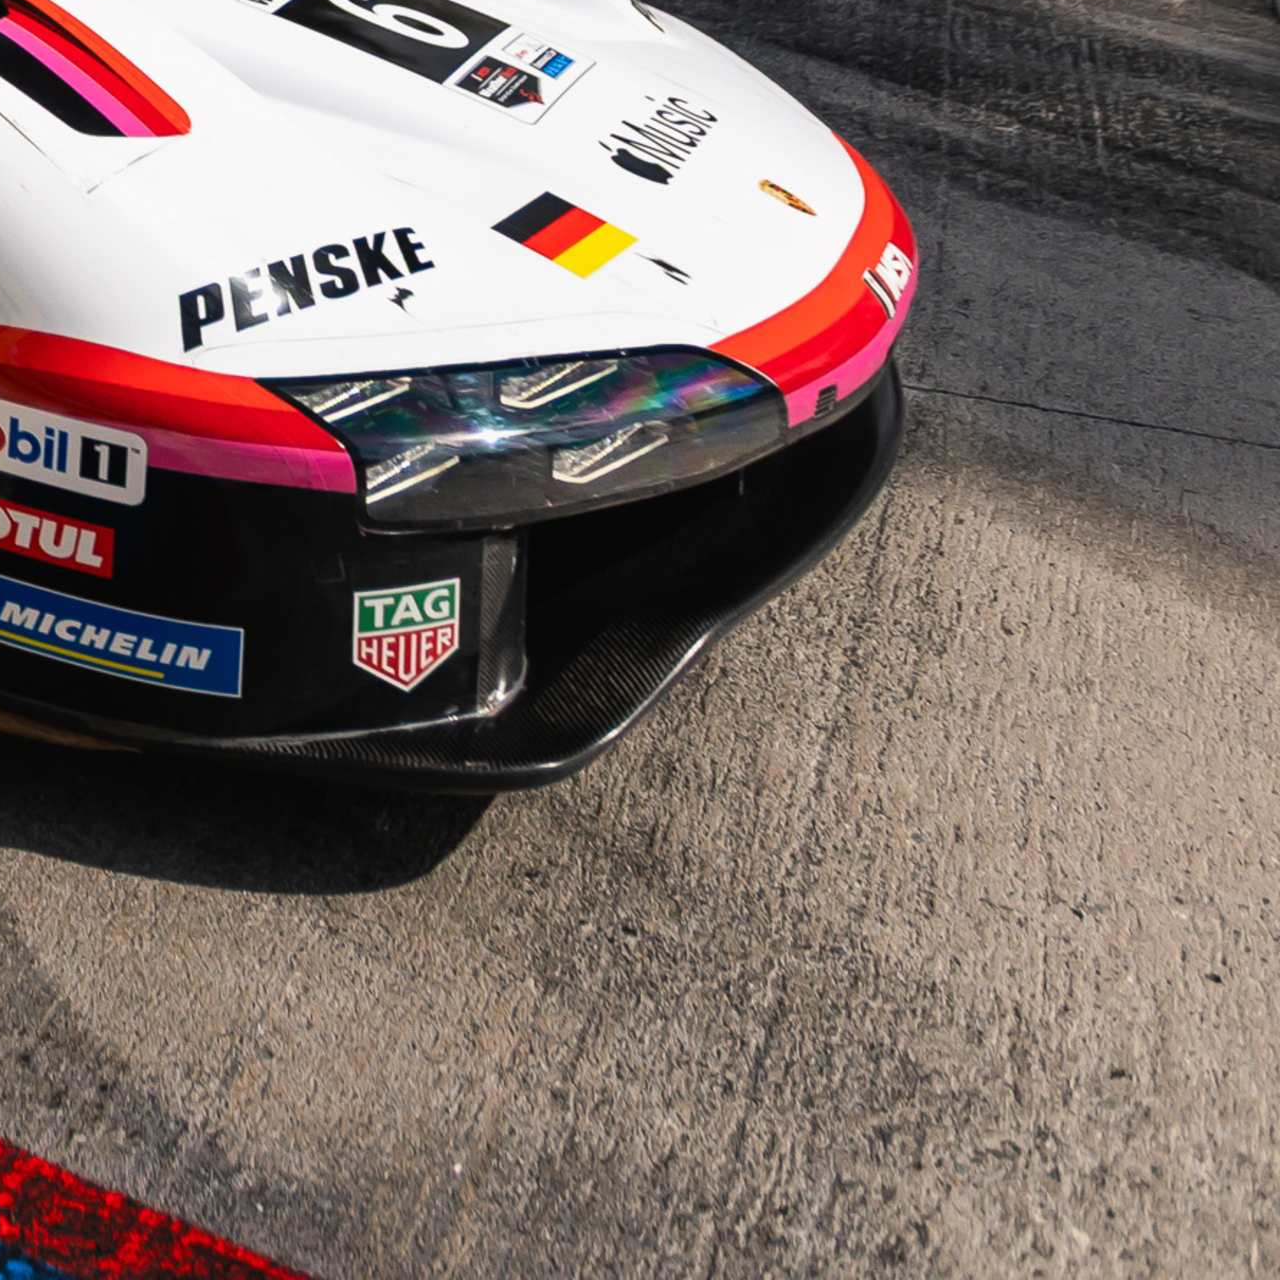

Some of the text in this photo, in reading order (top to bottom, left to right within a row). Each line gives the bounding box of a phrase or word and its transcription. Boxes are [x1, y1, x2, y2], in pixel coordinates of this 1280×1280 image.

[609, 95, 718, 170] Music
[178, 224, 435, 353] PENSKE
[0, 600, 213, 671] MICHELIN
[364, 588, 454, 624] TAG
[359, 620, 456, 685] HEUER
